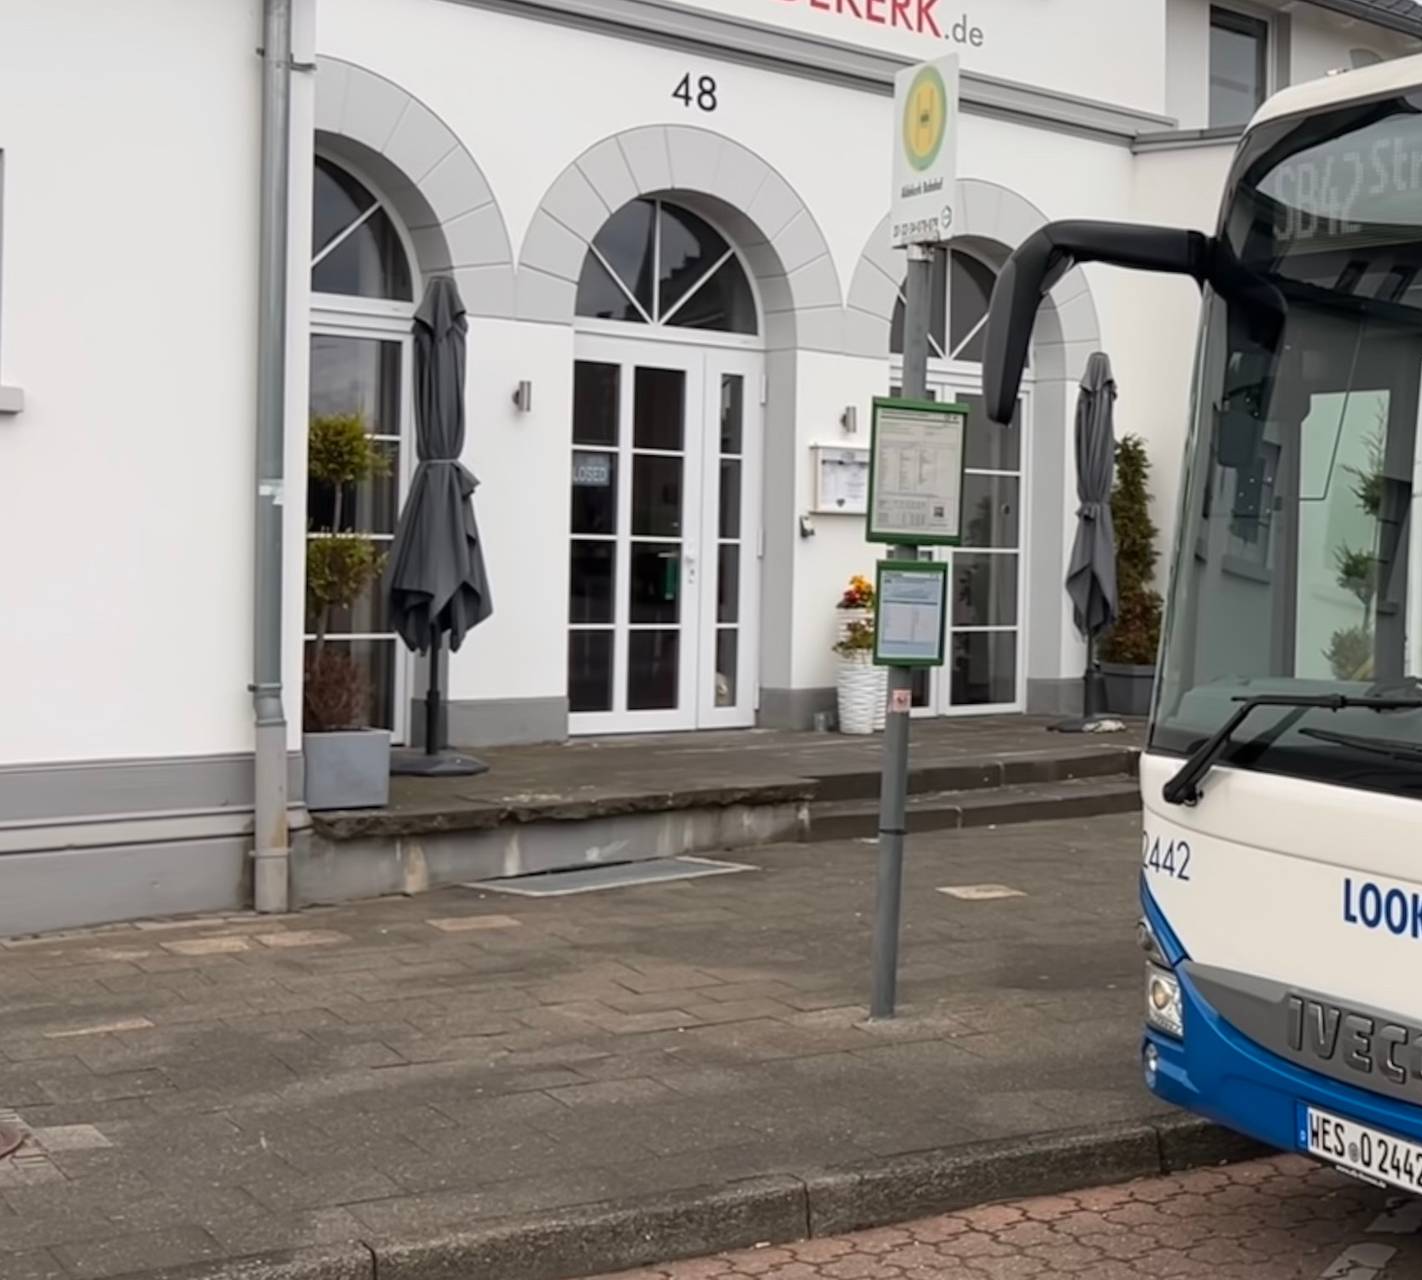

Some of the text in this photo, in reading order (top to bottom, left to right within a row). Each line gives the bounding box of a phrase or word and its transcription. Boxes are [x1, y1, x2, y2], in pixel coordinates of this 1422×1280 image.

[779, 0, 984, 47] ERK.de
[672, 72, 718, 112] 48
[1272, 150, 1364, 241] SB42
[1309, 1113, 1345, 1158] WES
